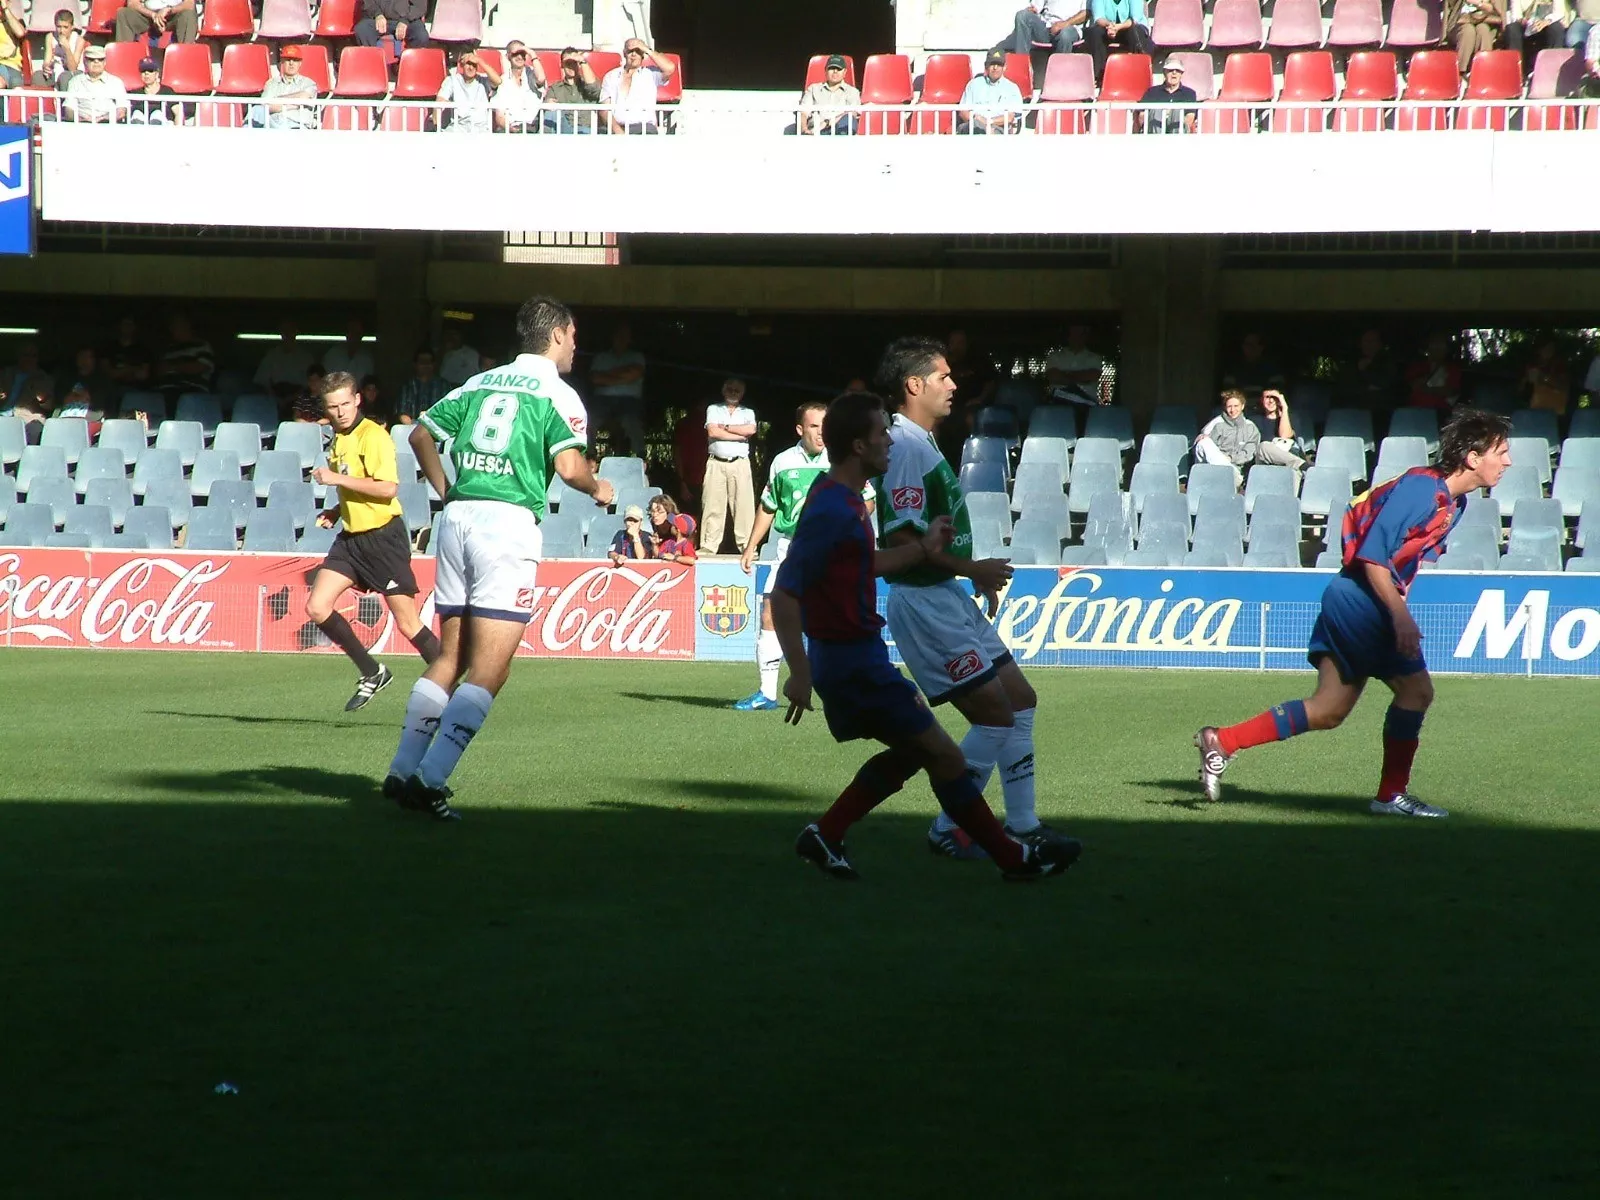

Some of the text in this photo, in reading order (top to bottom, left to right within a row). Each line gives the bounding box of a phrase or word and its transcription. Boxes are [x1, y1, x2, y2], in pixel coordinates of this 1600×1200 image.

[480, 373, 541, 391] BANZO
[471, 393, 519, 454] 8
[0, 553, 232, 643] oca-Cola
